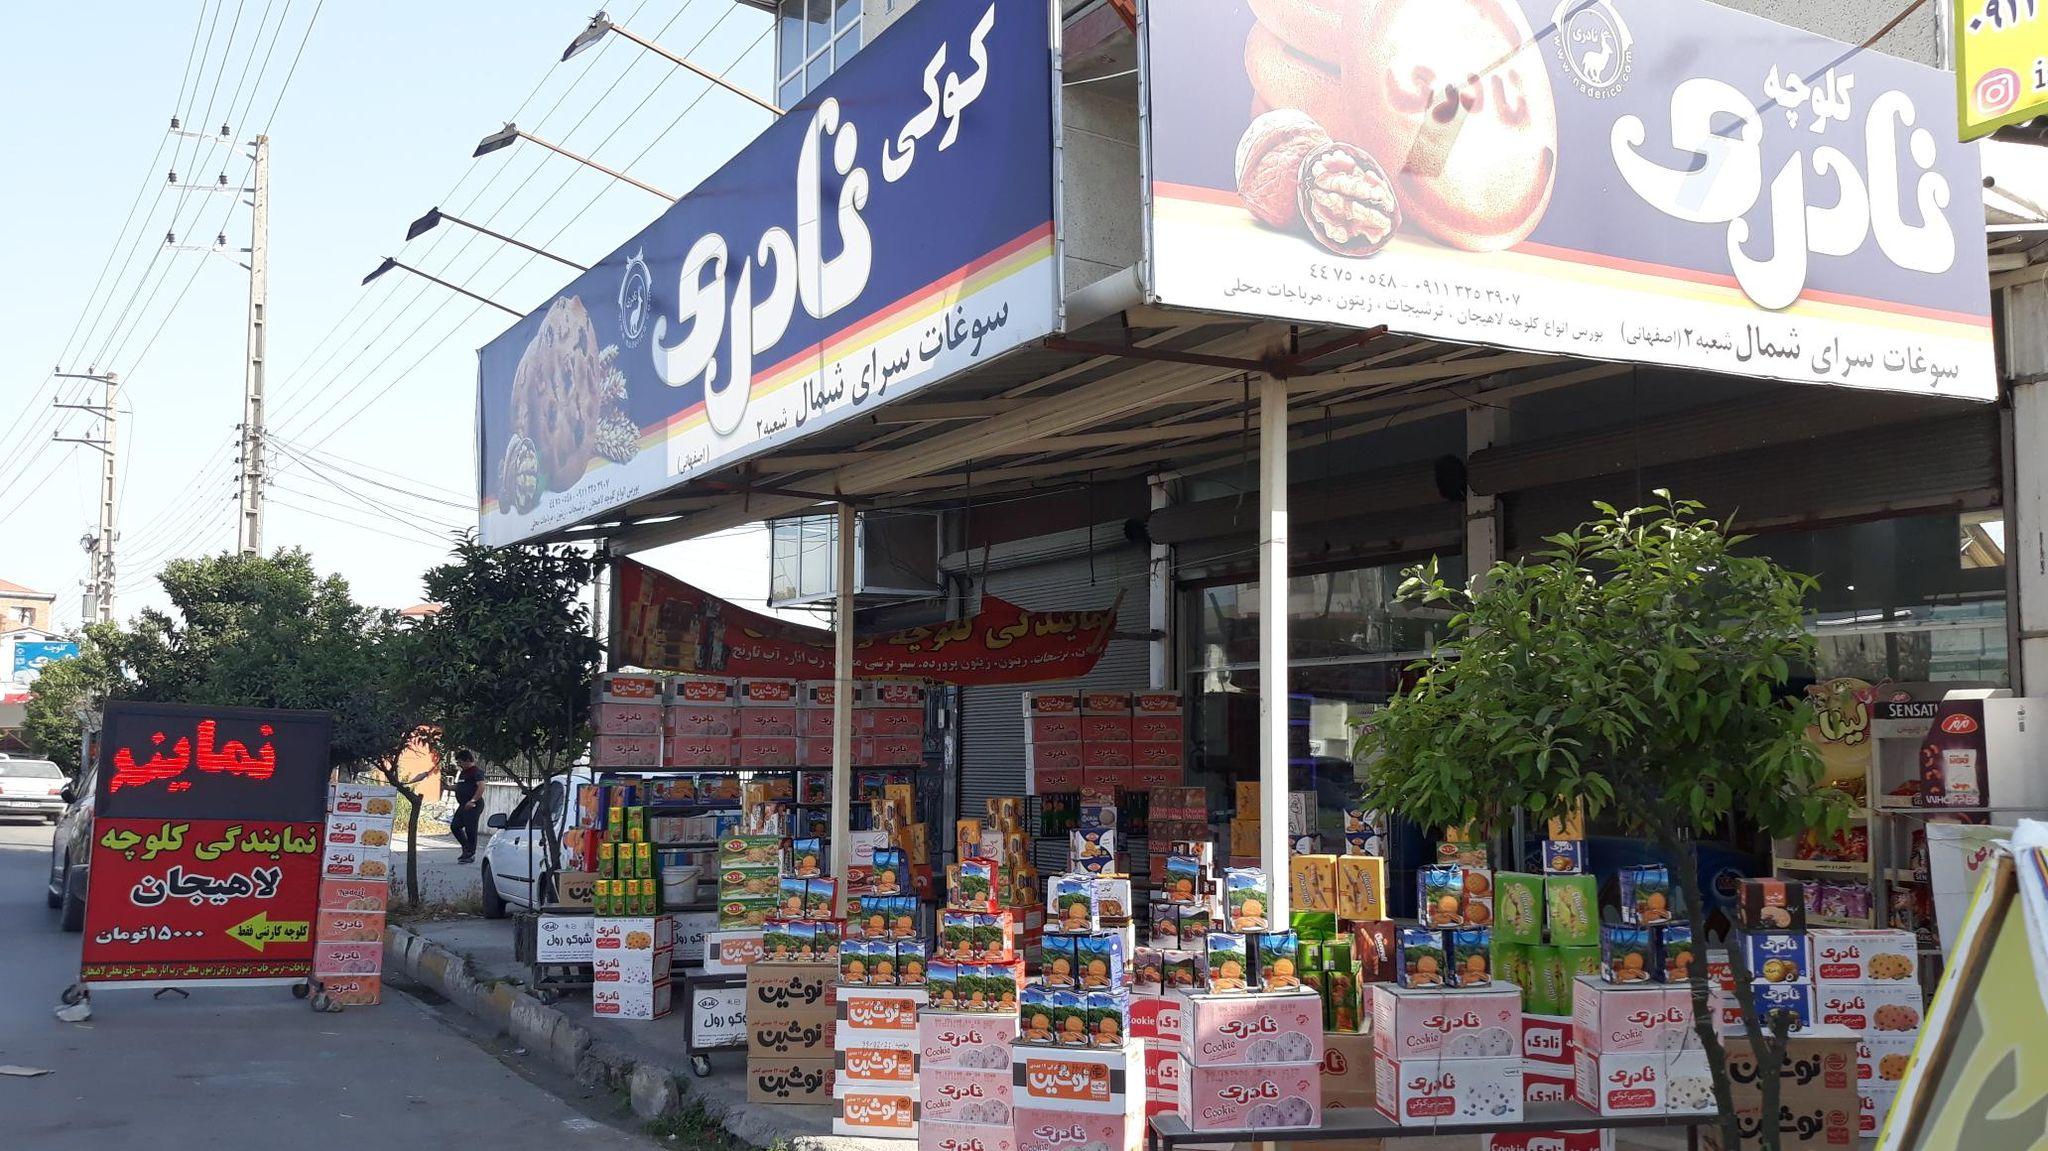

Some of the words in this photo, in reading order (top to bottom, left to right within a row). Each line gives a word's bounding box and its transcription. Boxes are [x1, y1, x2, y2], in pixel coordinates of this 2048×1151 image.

[1572, 27, 1599, 44] نادری
[882, 2, 995, 183] کوکی
[1763, 64, 1855, 133] کلوچه
[1610, 77, 1956, 310] نادری
[652, 97, 873, 435] نادری
[1222, 277, 1262, 297] محلی
[1386, 298, 1444, 320] ترشیجات
[1456, 307, 1504, 326] لاهیجان
[919, 300, 1009, 362] سوغات
[1507, 313, 1539, 331] کلوچه
[1544, 318, 1569, 339] انواع
[1571, 325, 1604, 342] بورس
[1696, 332, 1733, 351] شعبه
[1735, 324, 1801, 362] شمال
[1811, 337, 1874, 378] سرای
[1883, 346, 1959, 388] سوغات
[852, 347, 911, 407] سرای
[795, 362, 844, 428] شمال
[763, 407, 788, 440] شعبه
[101, 822, 191, 861] کلوچه
[195, 826, 318, 861] نمایندگی
[130, 864, 283, 906] لاهیجان
[284, 924, 308, 940] کلوچه
[546, 935, 564, 947] رول
[566, 932, 593, 945] شوکو
[596, 924, 621, 938] نادری
[722, 941, 764, 963] وشین
[1761, 939, 1798, 953] نادری
[1820, 945, 1861, 962] نادری
[595, 957, 620, 971] نادری
[595, 990, 620, 1003] نادری
[758, 976, 823, 1008] نوشین
[1762, 987, 1801, 1003] نادری
[851, 1000, 900, 1026] نوشین
[1824, 996, 1866, 1013] نادری
[703, 1013, 725, 1028] رول
[1131, 1015, 1156, 1026] ookie
[1218, 1015, 1278, 1039] نادری
[1423, 1011, 1482, 1033] نادری
[1627, 1006, 1684, 1029] نادری
[756, 1020, 822, 1053] نوشین
[937, 1029, 984, 1047] نادری
[1203, 1039, 1236, 1055] Cookie
[1406, 1033, 1440, 1048] Cookie
[1611, 1029, 1643, 1043] Cookie
[925, 1047, 951, 1058] Cookie
[847, 1051, 898, 1077] نوشین
[758, 1065, 823, 1098] نوشین
[1029, 1064, 1090, 1094] نوشین
[1408, 1072, 1456, 1096] نادری
[1608, 1065, 1656, 1088] نادری
[938, 1083, 985, 1100] نادری
[1218, 1080, 1279, 1104] نادری
[846, 1097, 897, 1124] نوشین
[925, 1099, 951, 1111] Cookie
[1202, 1104, 1236, 1119] Cookie
[1034, 1124, 1087, 1143] نادری
